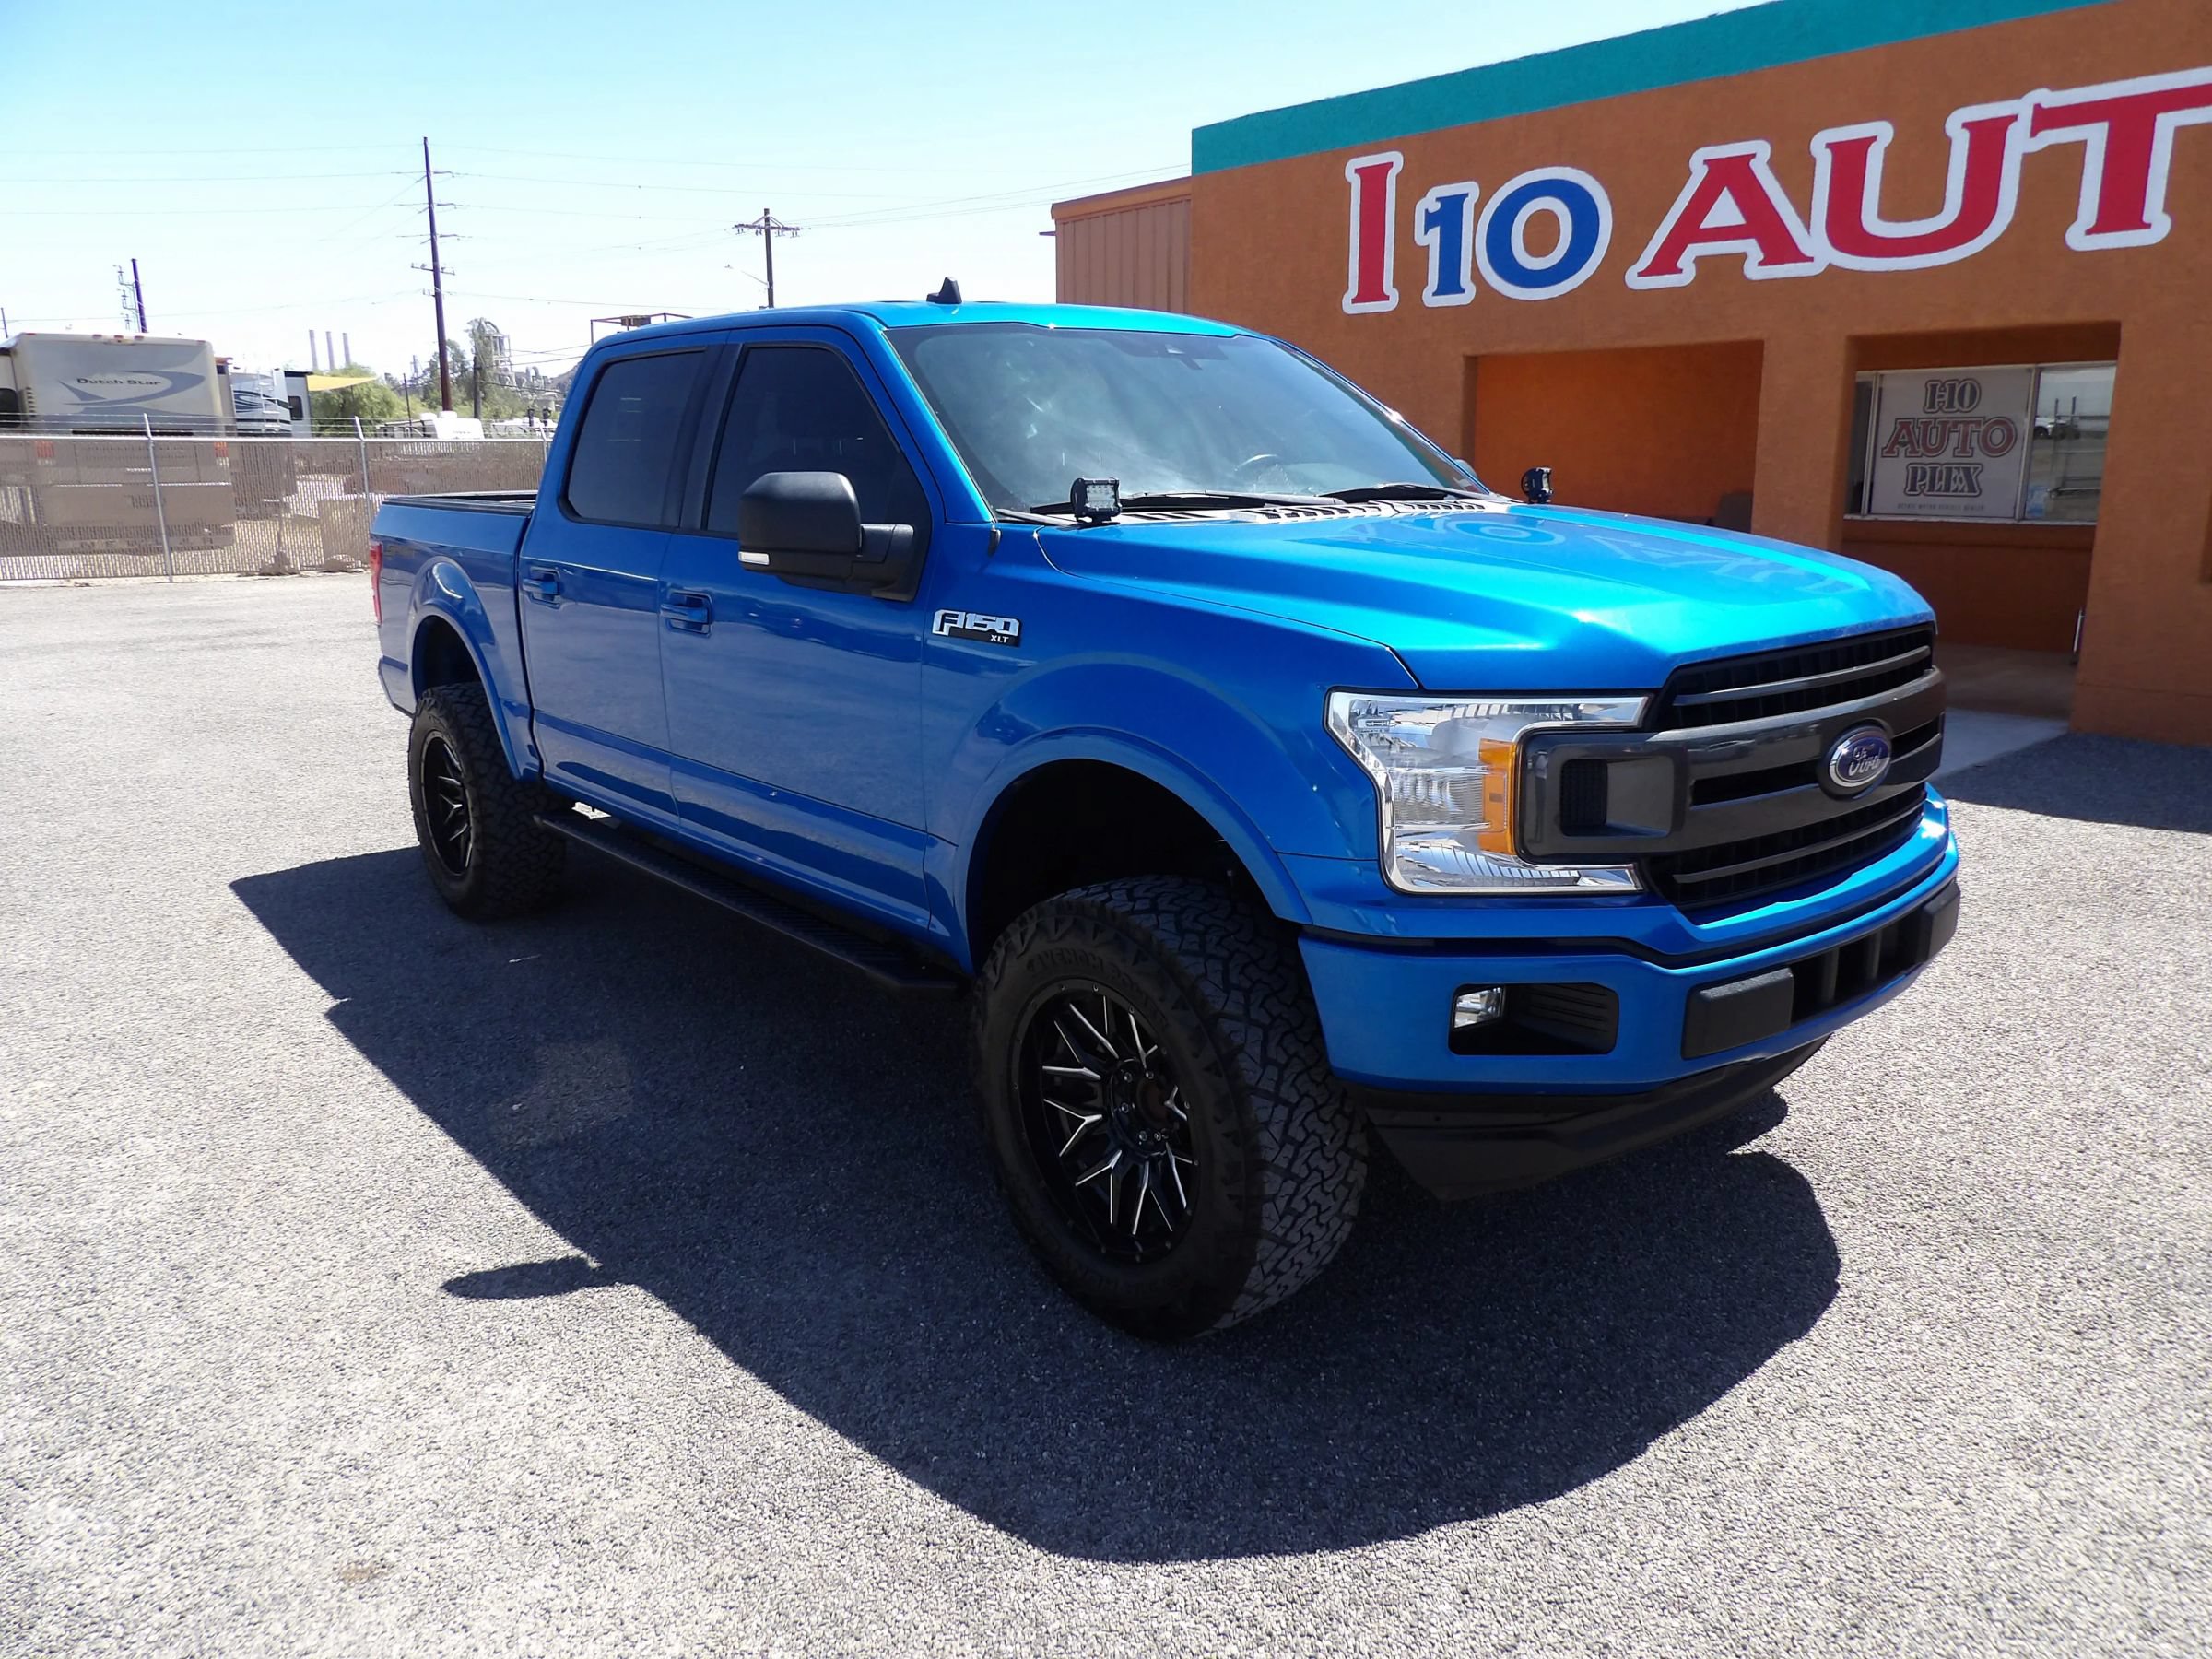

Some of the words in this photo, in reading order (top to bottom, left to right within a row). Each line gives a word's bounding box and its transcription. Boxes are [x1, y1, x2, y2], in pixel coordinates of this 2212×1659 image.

[1881, 417, 2018, 458] AUTO
[1904, 463, 1983, 498] PLEX
[990, 634, 1009, 643] XLT
[1848, 742, 1883, 777] Ford
